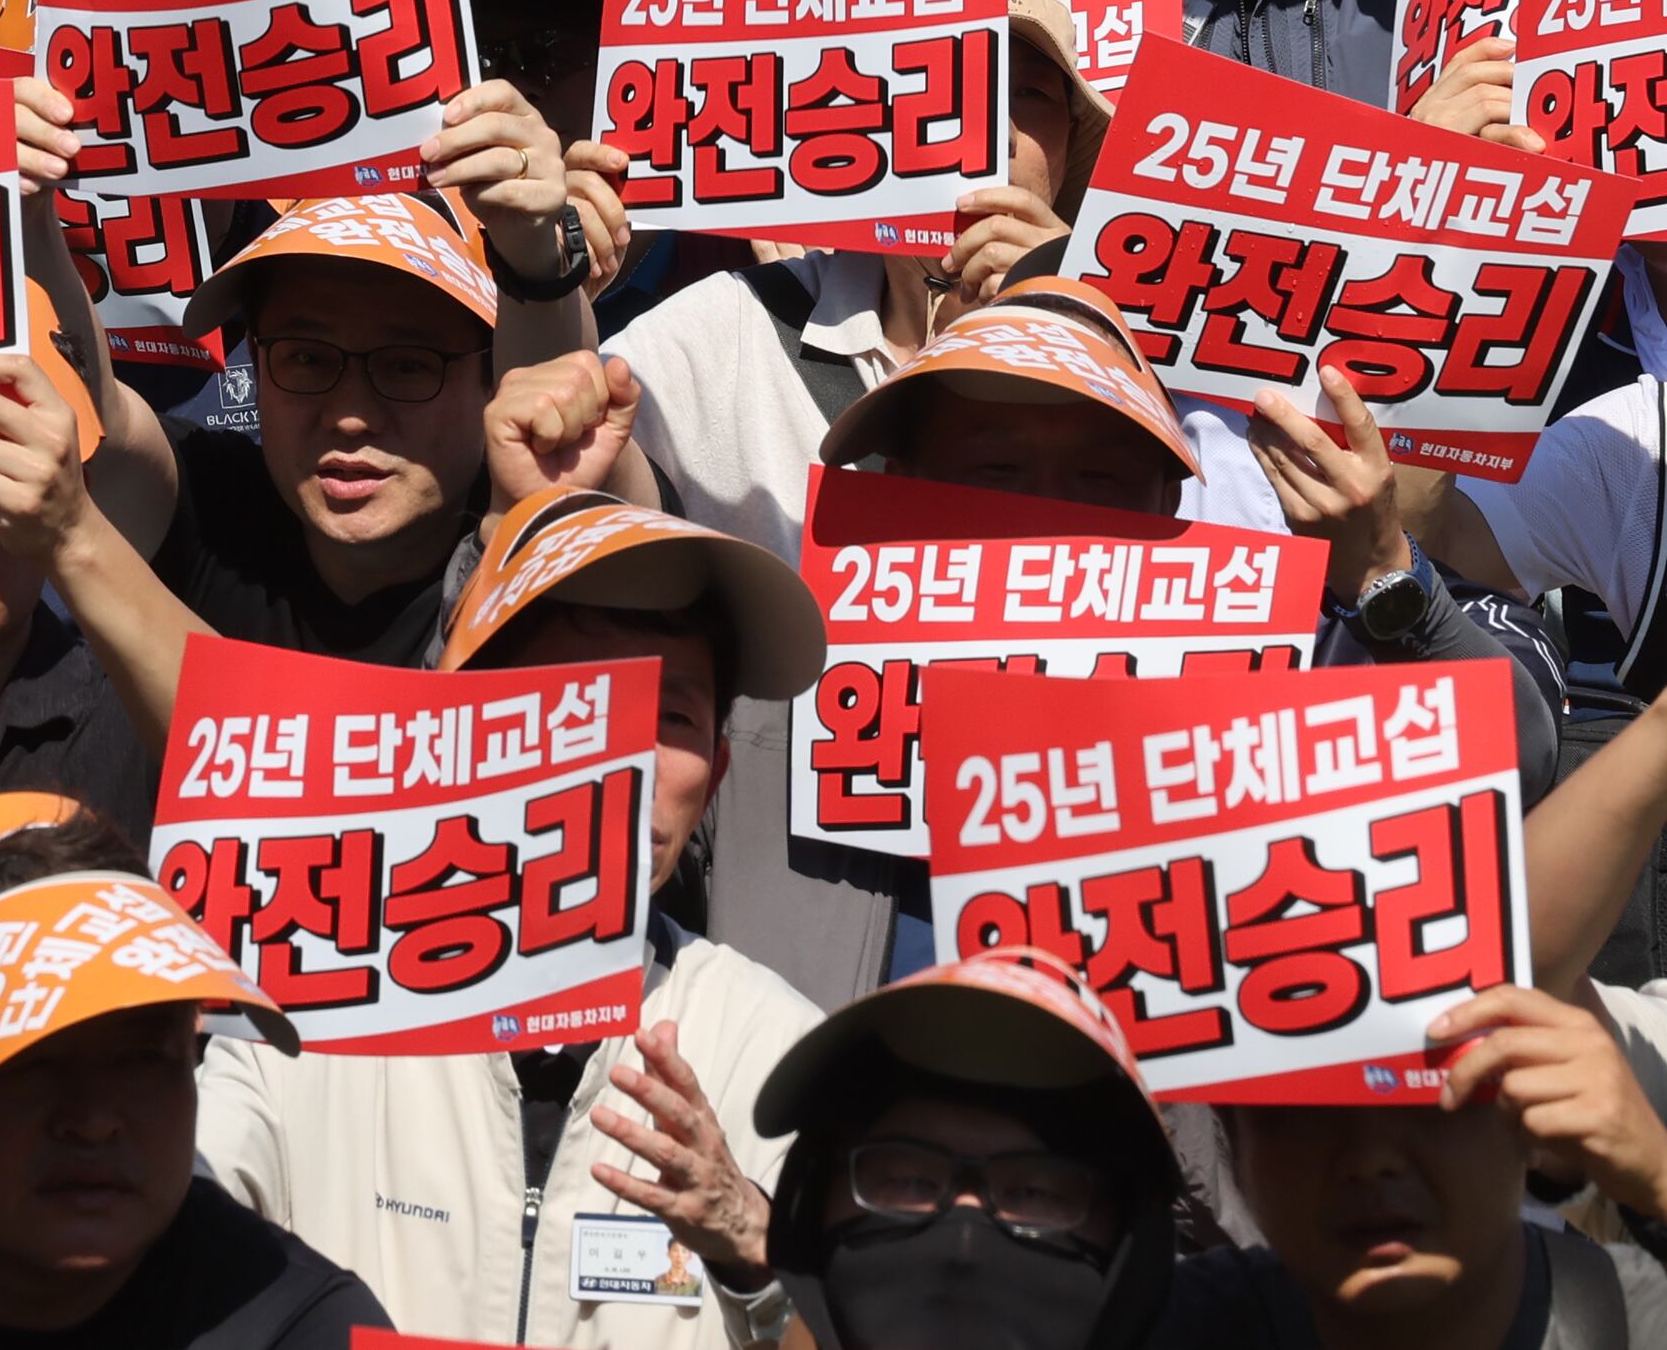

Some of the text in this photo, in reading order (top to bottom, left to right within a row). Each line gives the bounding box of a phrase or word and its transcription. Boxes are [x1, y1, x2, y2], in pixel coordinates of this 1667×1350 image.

[601, 30, 996, 209] 완전승리
[1133, 112, 1592, 246] 25년 단체교섭
[1081, 213, 1597, 405] 완전승리
[1419, 440, 1514, 470] 현대자동차지부
[830, 544, 1280, 624] 25년 단체교섭
[179, 674, 610, 798] 25년 단체교섭
[953, 678, 1462, 846] 25년 단체교섭
[158, 767, 640, 1007] 완전승리
[526, 1005, 628, 1035] 현대자동차지부
[386, 1199, 450, 1223] HYUNDAI
